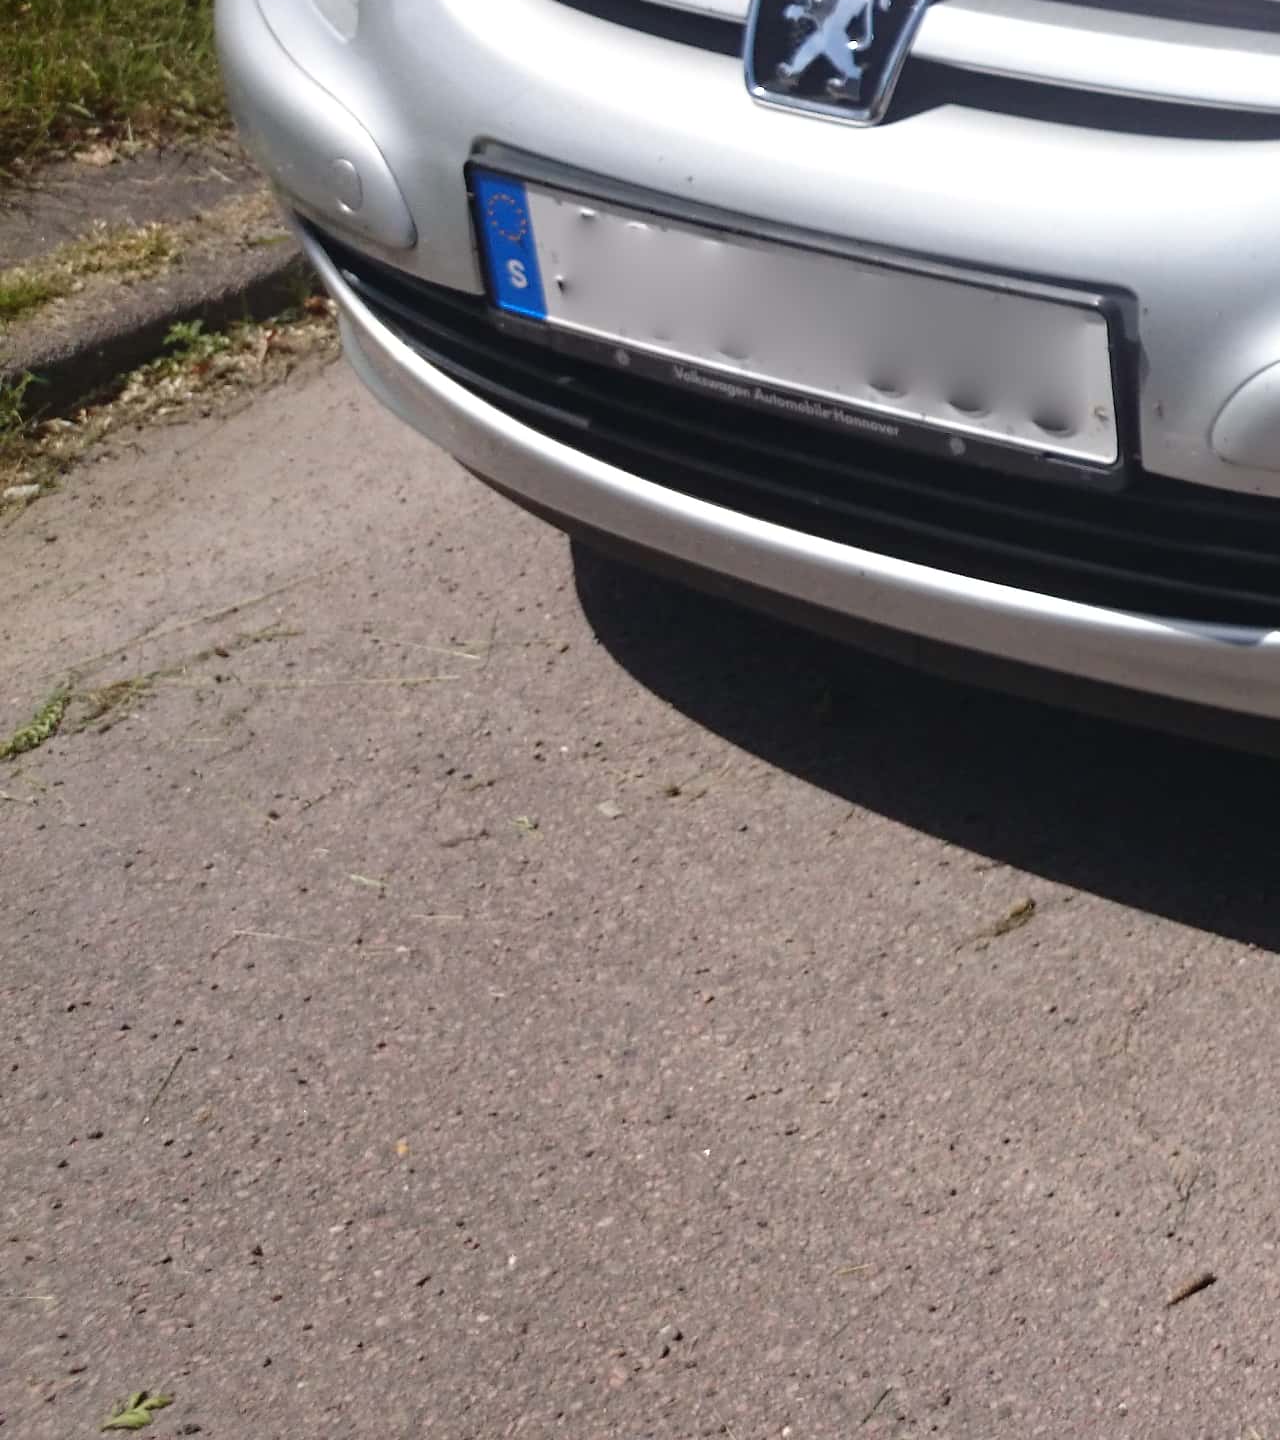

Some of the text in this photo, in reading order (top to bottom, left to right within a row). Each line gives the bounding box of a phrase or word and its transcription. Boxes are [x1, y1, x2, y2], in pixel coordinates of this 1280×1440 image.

[507, 259, 528, 289] S
[672, 364, 899, 436] Volkswagen Automobile Hannover
